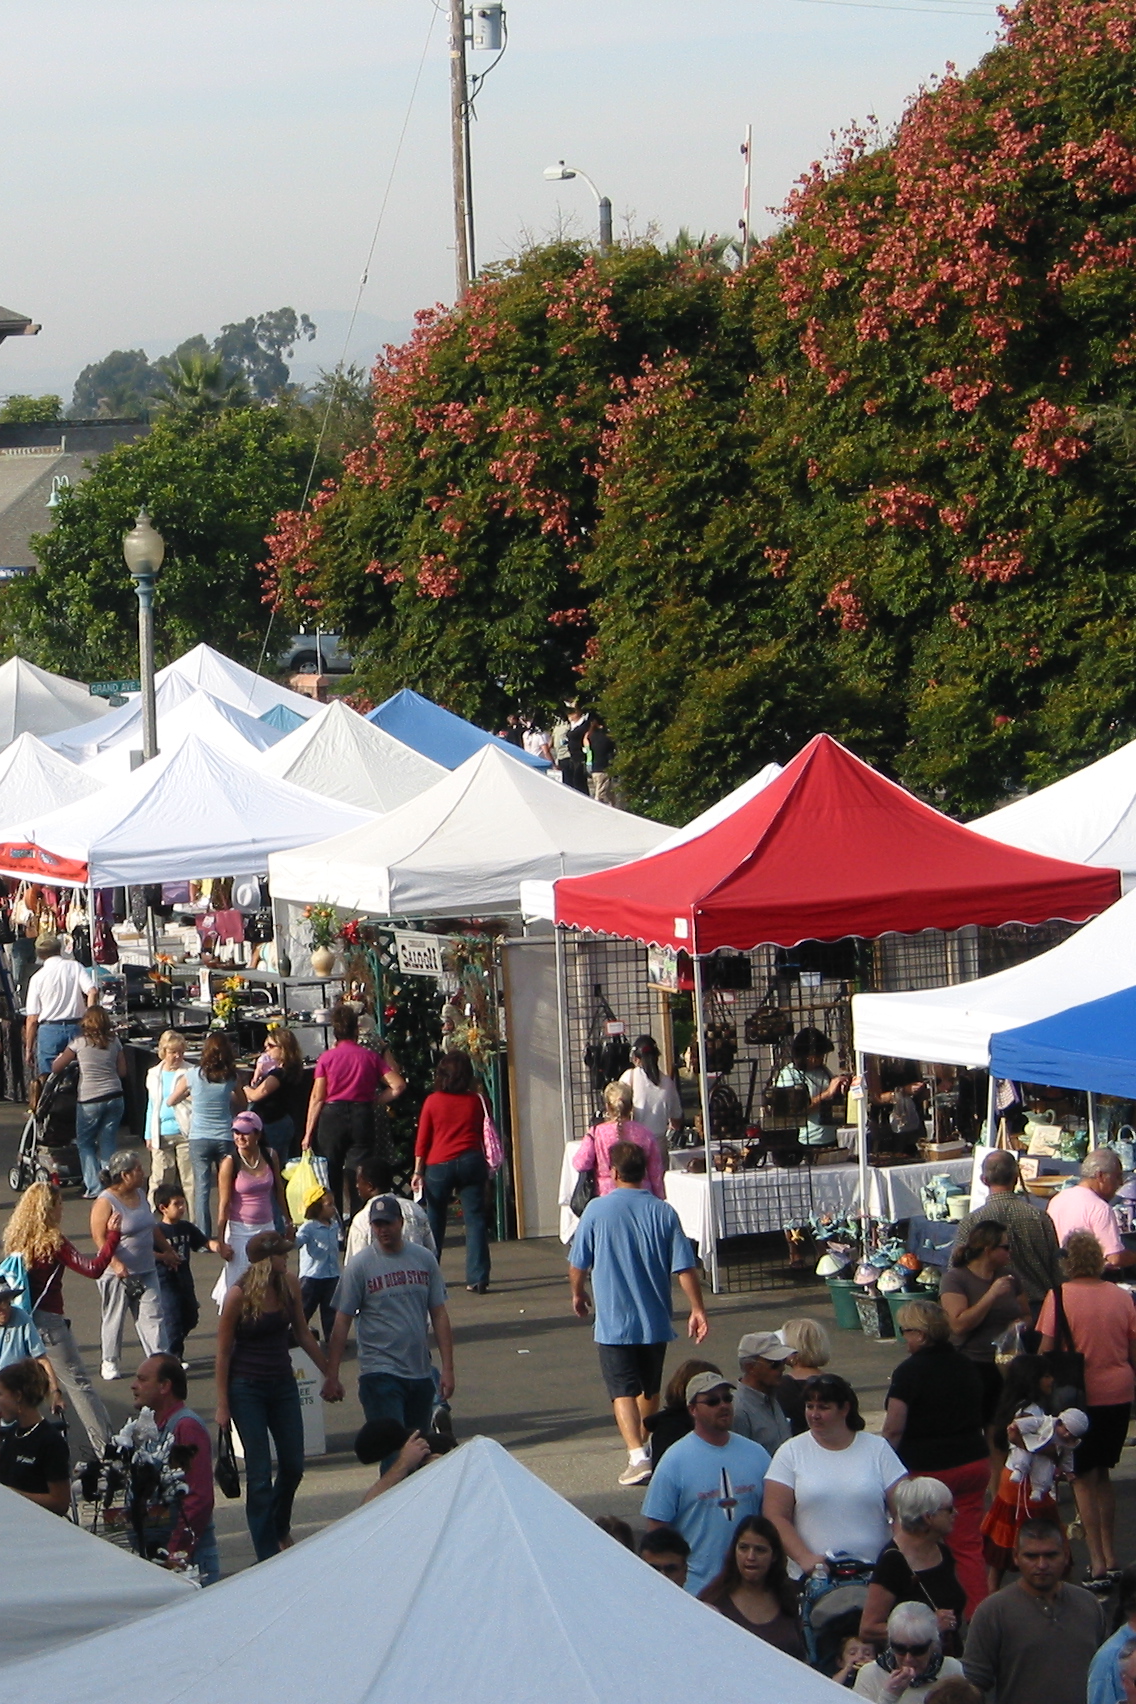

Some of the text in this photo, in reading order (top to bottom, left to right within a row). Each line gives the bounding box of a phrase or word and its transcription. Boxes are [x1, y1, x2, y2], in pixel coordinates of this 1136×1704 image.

[90, 680, 136, 694] GRAND AVE
[367, 1269, 430, 1293] SAN DIEGO STATE
